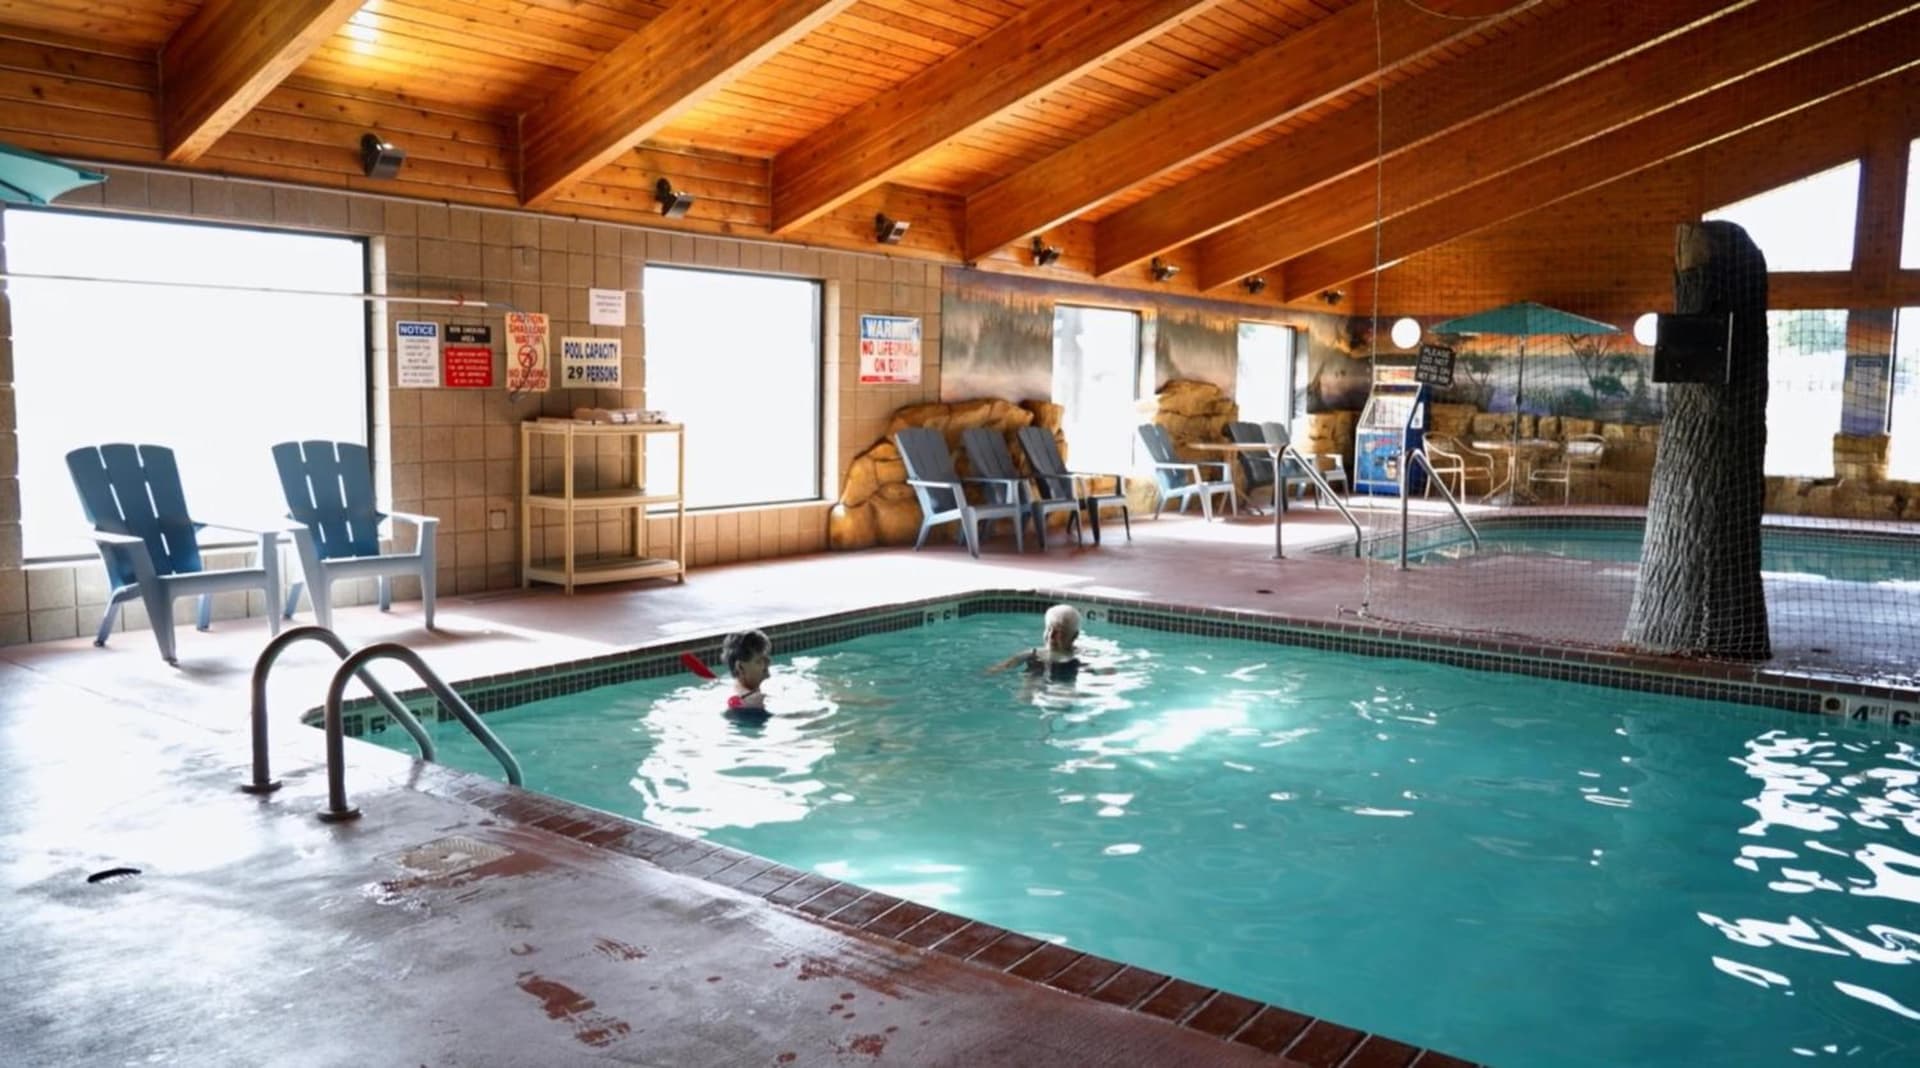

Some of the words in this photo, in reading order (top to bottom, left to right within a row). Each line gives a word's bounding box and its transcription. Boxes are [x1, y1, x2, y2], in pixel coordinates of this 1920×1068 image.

[400, 325, 434, 335] NOTICE
[565, 342, 583, 359] POOL
[586, 342, 617, 359] CAPACITY
[863, 341, 874, 356] NO
[509, 368, 520, 378] NO
[567, 365, 584, 380] 29
[587, 365, 618, 382] PERSONS
[874, 358, 886, 373] ON
[1852, 705, 1869, 722] 4
[371, 716, 386, 734] 5
